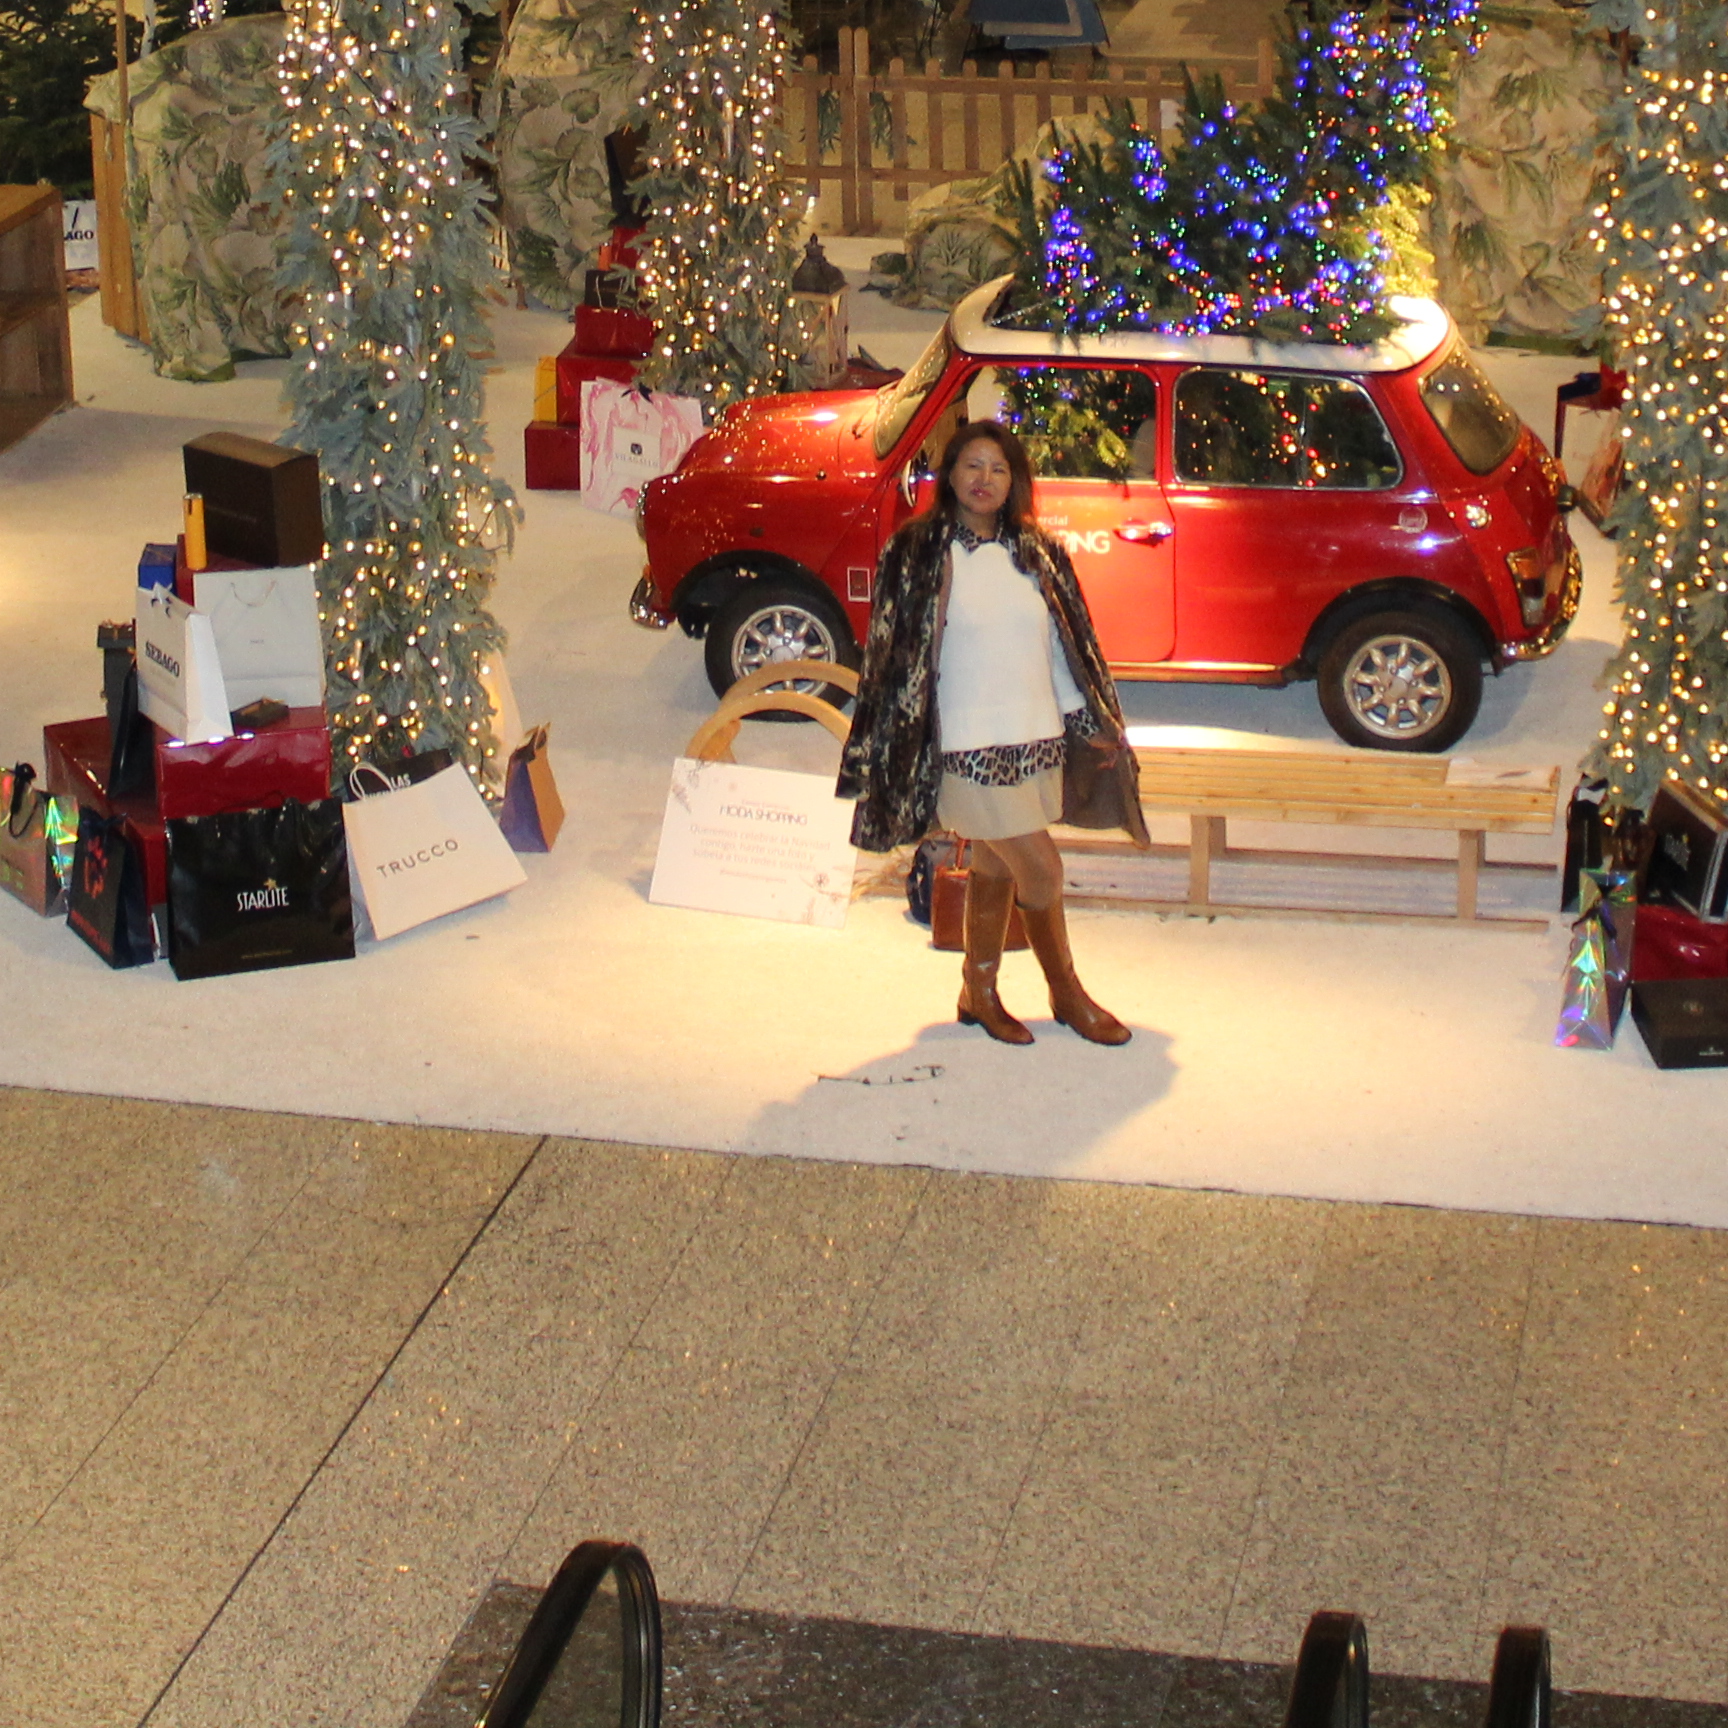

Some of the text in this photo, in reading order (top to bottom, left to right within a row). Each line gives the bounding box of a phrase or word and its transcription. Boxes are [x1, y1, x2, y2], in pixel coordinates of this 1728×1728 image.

[145, 640, 181, 678] SEBAGO
[390, 772, 412, 790] LAS
[376, 839, 459, 879] TRUCCO
[237, 885, 290, 912] STARLITE
